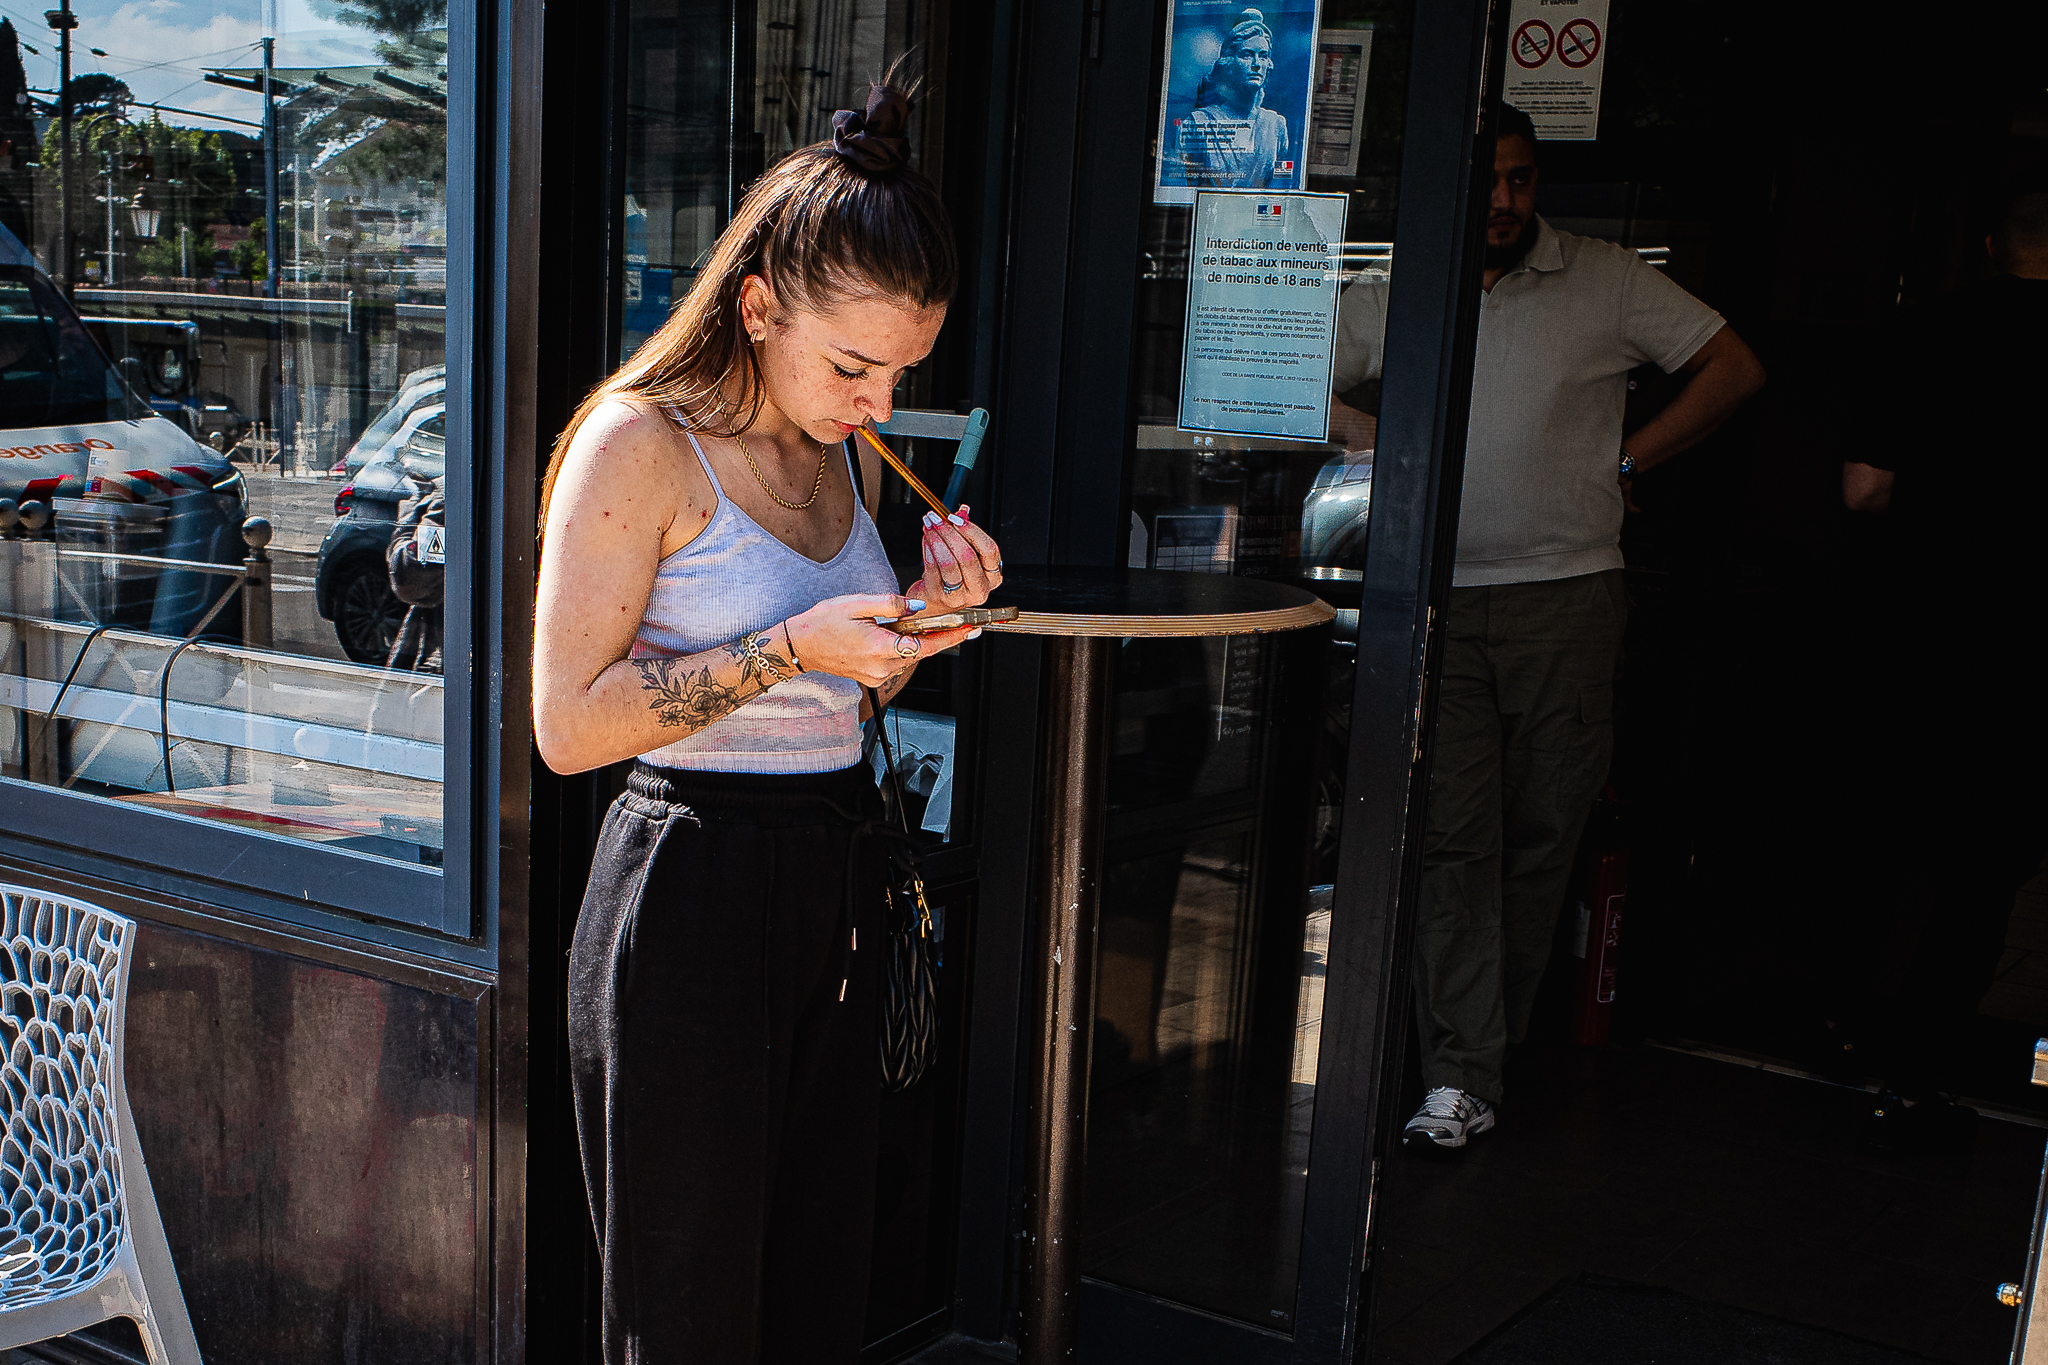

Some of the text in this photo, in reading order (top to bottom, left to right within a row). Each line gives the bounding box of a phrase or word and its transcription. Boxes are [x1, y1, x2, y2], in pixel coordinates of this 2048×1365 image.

[1207, 237, 1328, 253] Interdiction de vente
[1202, 255, 1329, 270] de tabac aux mineurs
[1207, 272, 1321, 287] de moins de 18 ans
[1279, 309, 1313, 317] gratuitement,
[1301, 352, 1316, 360] exige
[1256, 408, 1286, 416] judiciaires.
